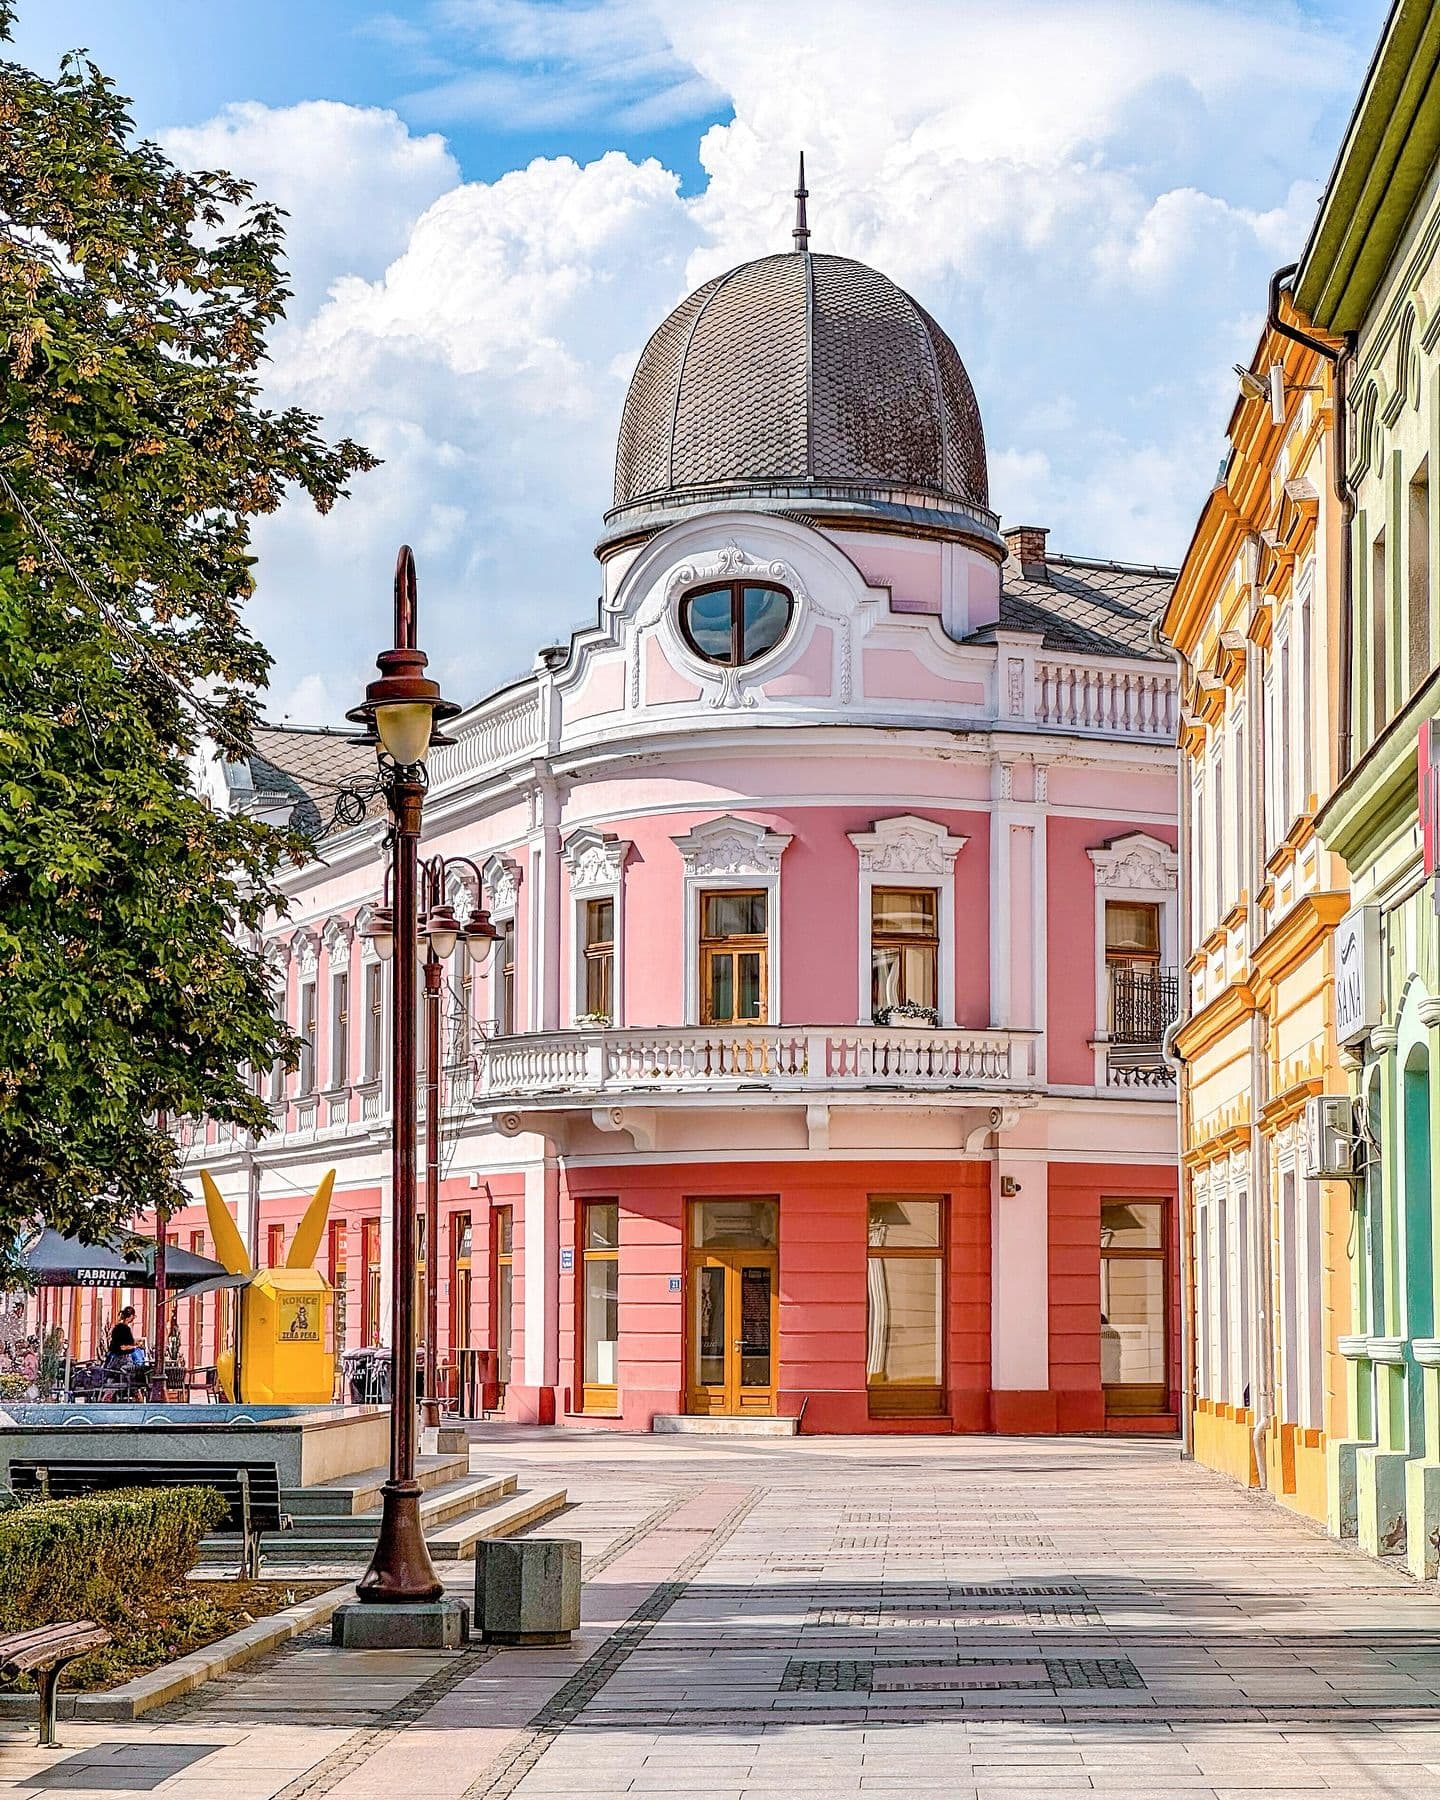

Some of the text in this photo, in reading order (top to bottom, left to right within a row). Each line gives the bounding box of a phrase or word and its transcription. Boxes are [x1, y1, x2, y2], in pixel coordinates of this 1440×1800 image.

[1337, 967, 1361, 1028] SANA
[77, 1269, 127, 1280] FABRIKA
[282, 1296, 318, 1305] KOKICE
